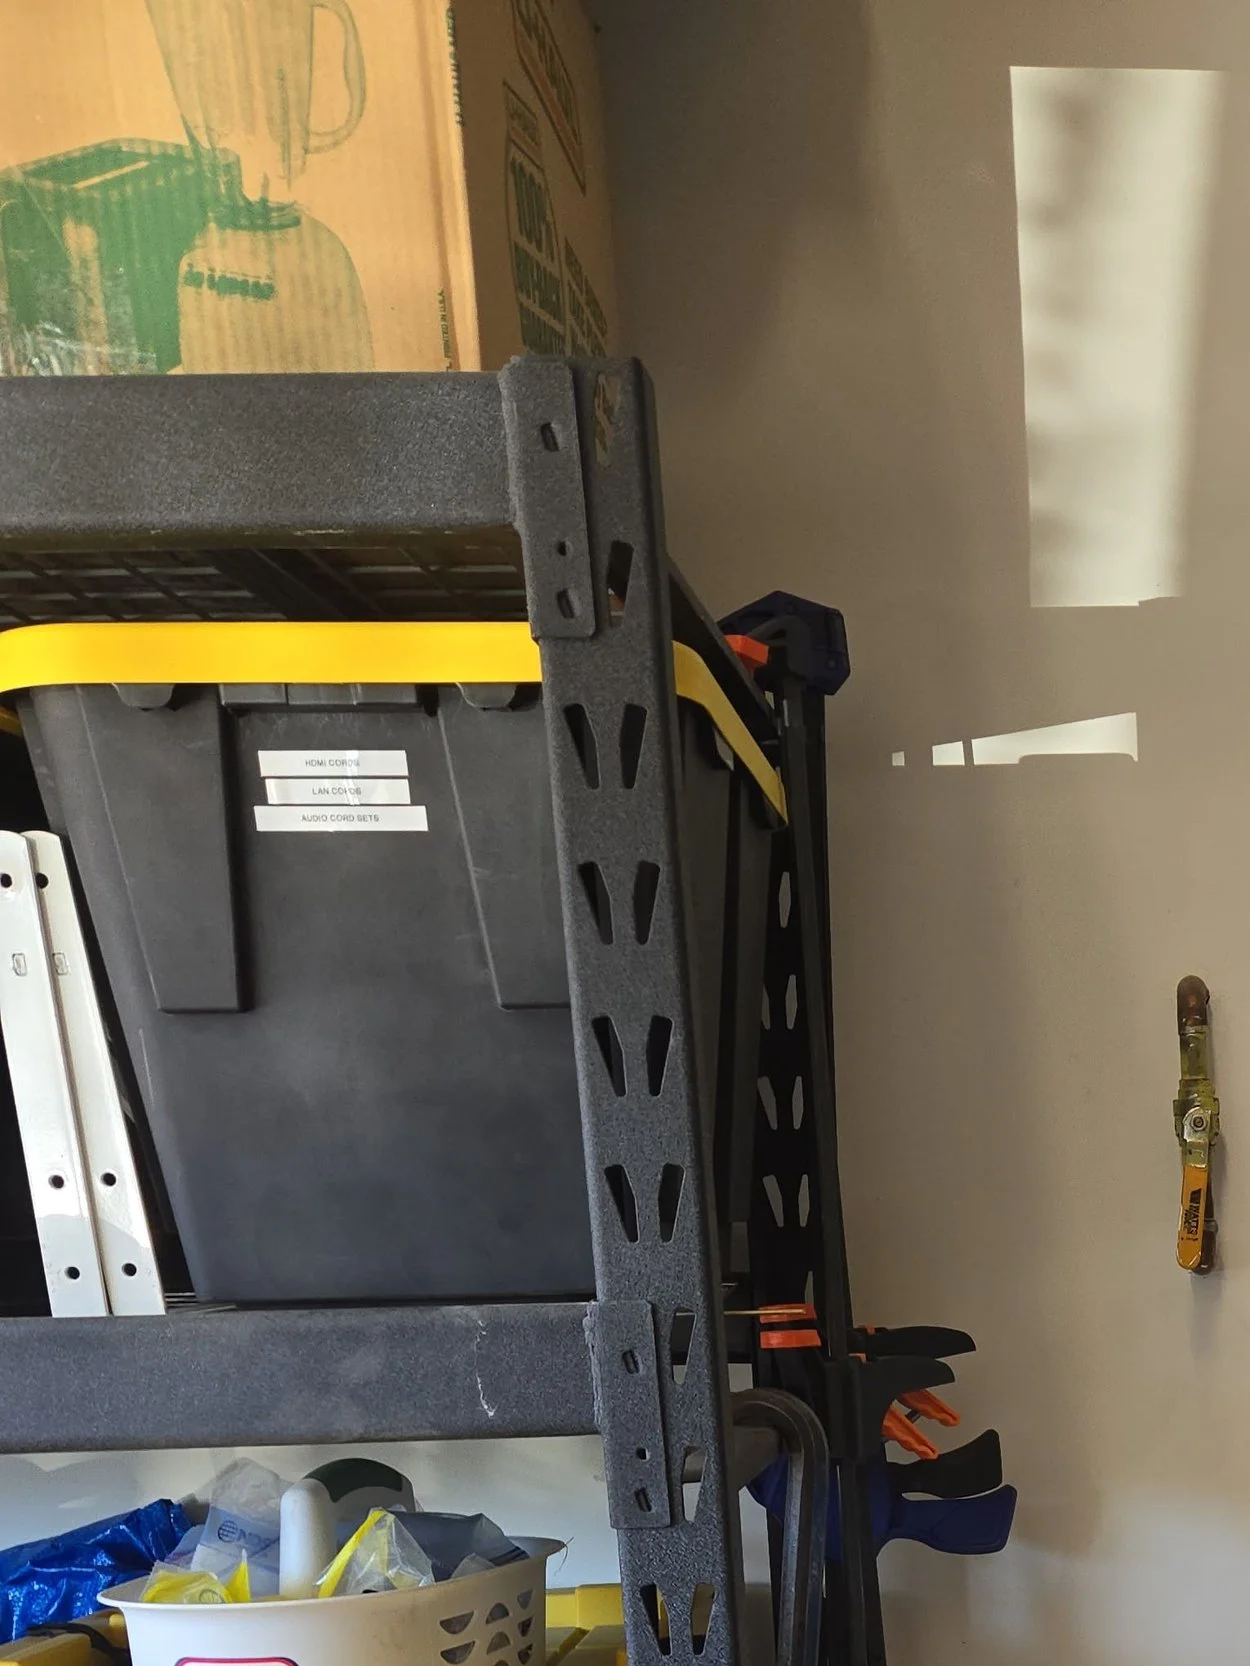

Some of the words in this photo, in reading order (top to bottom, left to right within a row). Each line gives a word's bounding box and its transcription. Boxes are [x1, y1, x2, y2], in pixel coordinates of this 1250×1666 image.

[305, 759, 327, 767] HDMI
[311, 788, 330, 796] LAN
[301, 814, 328, 822] AUDIO
[330, 814, 355, 822] CORD
[357, 814, 379, 822] SETS
